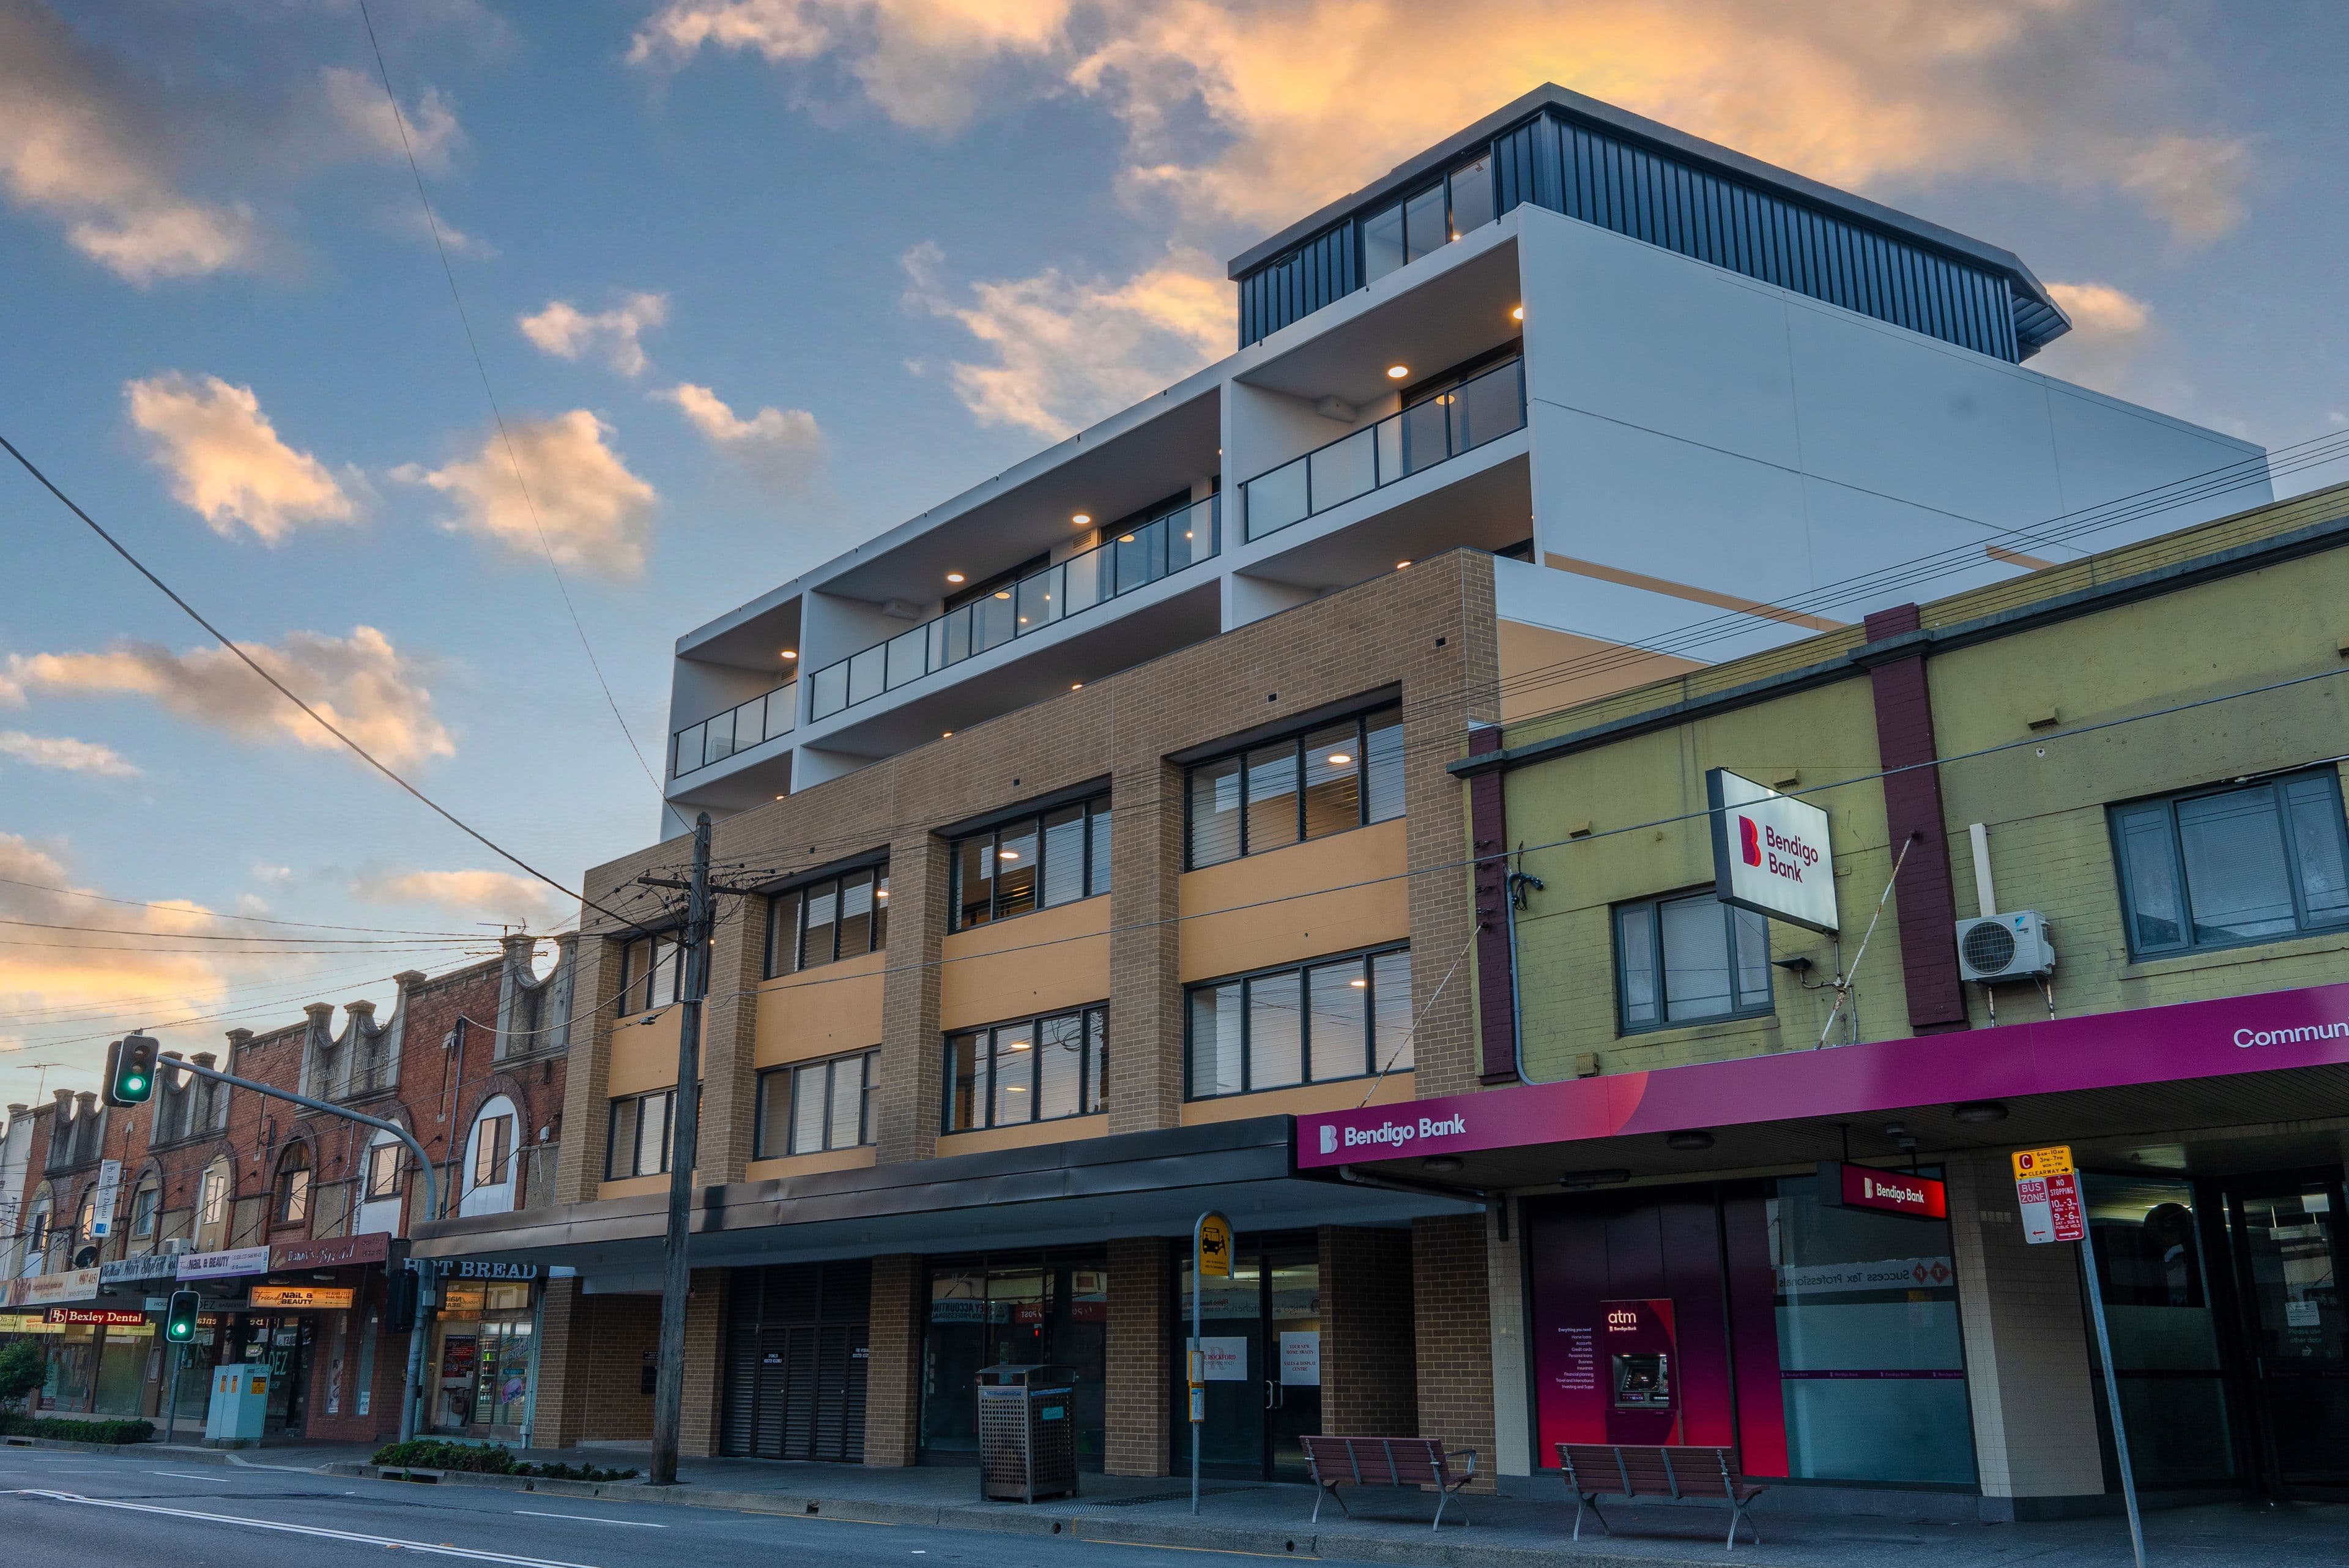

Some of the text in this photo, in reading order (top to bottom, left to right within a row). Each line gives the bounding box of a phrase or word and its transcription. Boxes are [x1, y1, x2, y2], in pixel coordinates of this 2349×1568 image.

[1765, 825, 1819, 867] Bendigo
[1768, 852, 1803, 883] Bank
[2234, 1020, 2349, 1048] Commun
[355, 1052, 390, 1074] BUILDINGS
[317, 1066, 338, 1083] BIRKIN
[1345, 1121, 1415, 1148] Bendigo
[1419, 1113, 1466, 1139] Bank
[2022, 1155, 2031, 1168] C
[1876, 1183, 1905, 1203] Bendigo
[1906, 1188, 1924, 1203] Bank
[2022, 1183, 2041, 1193] BUS
[2050, 1187, 2074, 1196] STOPPING
[2021, 1192, 2046, 1203] ZONE
[101, 1198, 110, 1219] Dental
[123, 1259, 139, 1276] Hair
[141, 1255, 167, 1277] Stylist
[209, 1256, 229, 1268] BEAUTY
[459, 1261, 537, 1279] BREAD
[254, 1291, 282, 1305] Friendly
[69, 1311, 104, 1323] Bexley
[106, 1312, 141, 1322] Dental
[1608, 1310, 1637, 1324] atm
